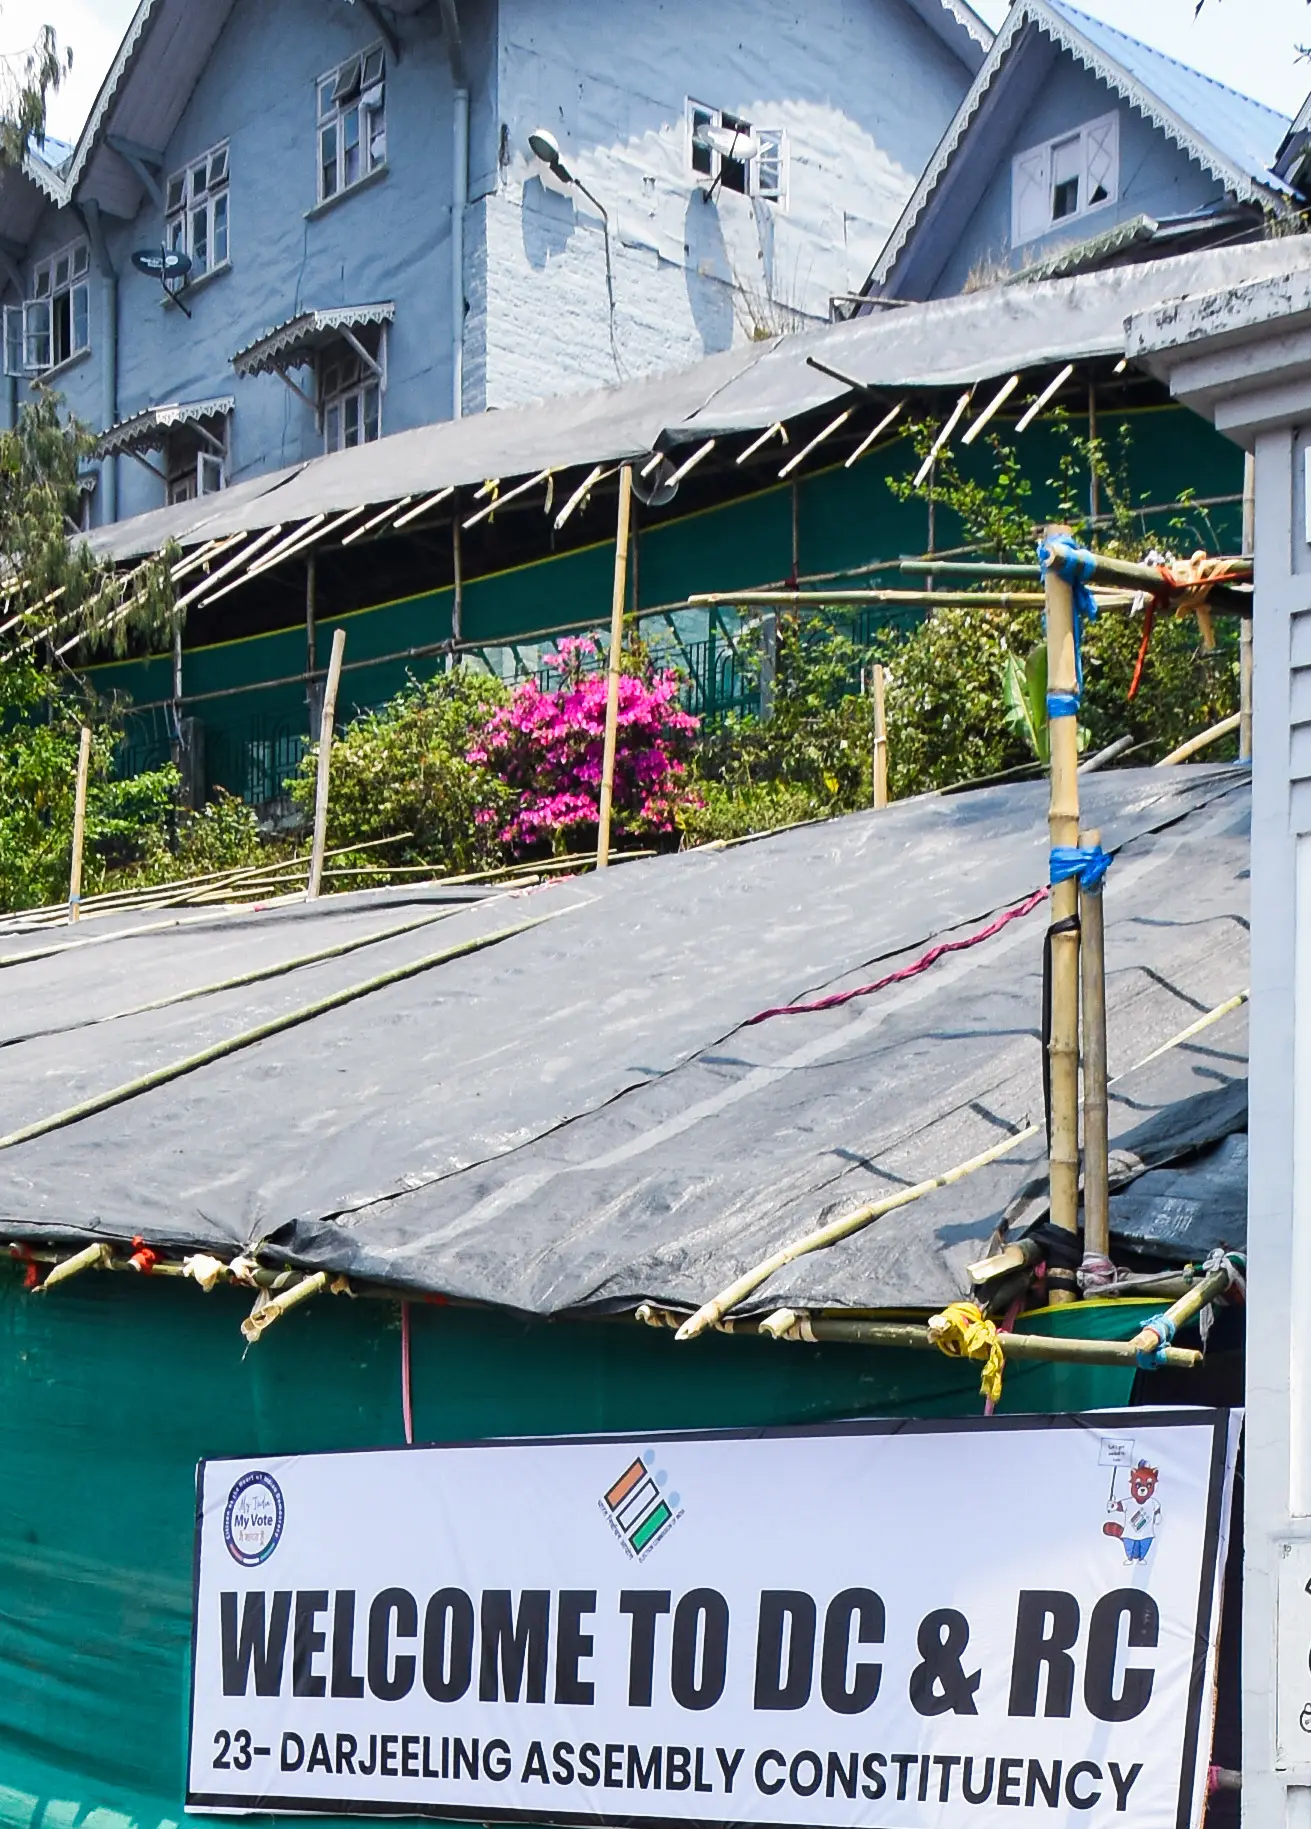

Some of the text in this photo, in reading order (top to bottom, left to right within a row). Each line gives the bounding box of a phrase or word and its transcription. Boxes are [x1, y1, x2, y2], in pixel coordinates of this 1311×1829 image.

[234, 1513, 273, 1529] My Vote
[219, 1587, 1160, 1722] WELCOME TO DC & RC
[212, 1728, 1144, 1812] 23- DARJEELING ASSEMBLY CONSTITUENCY
